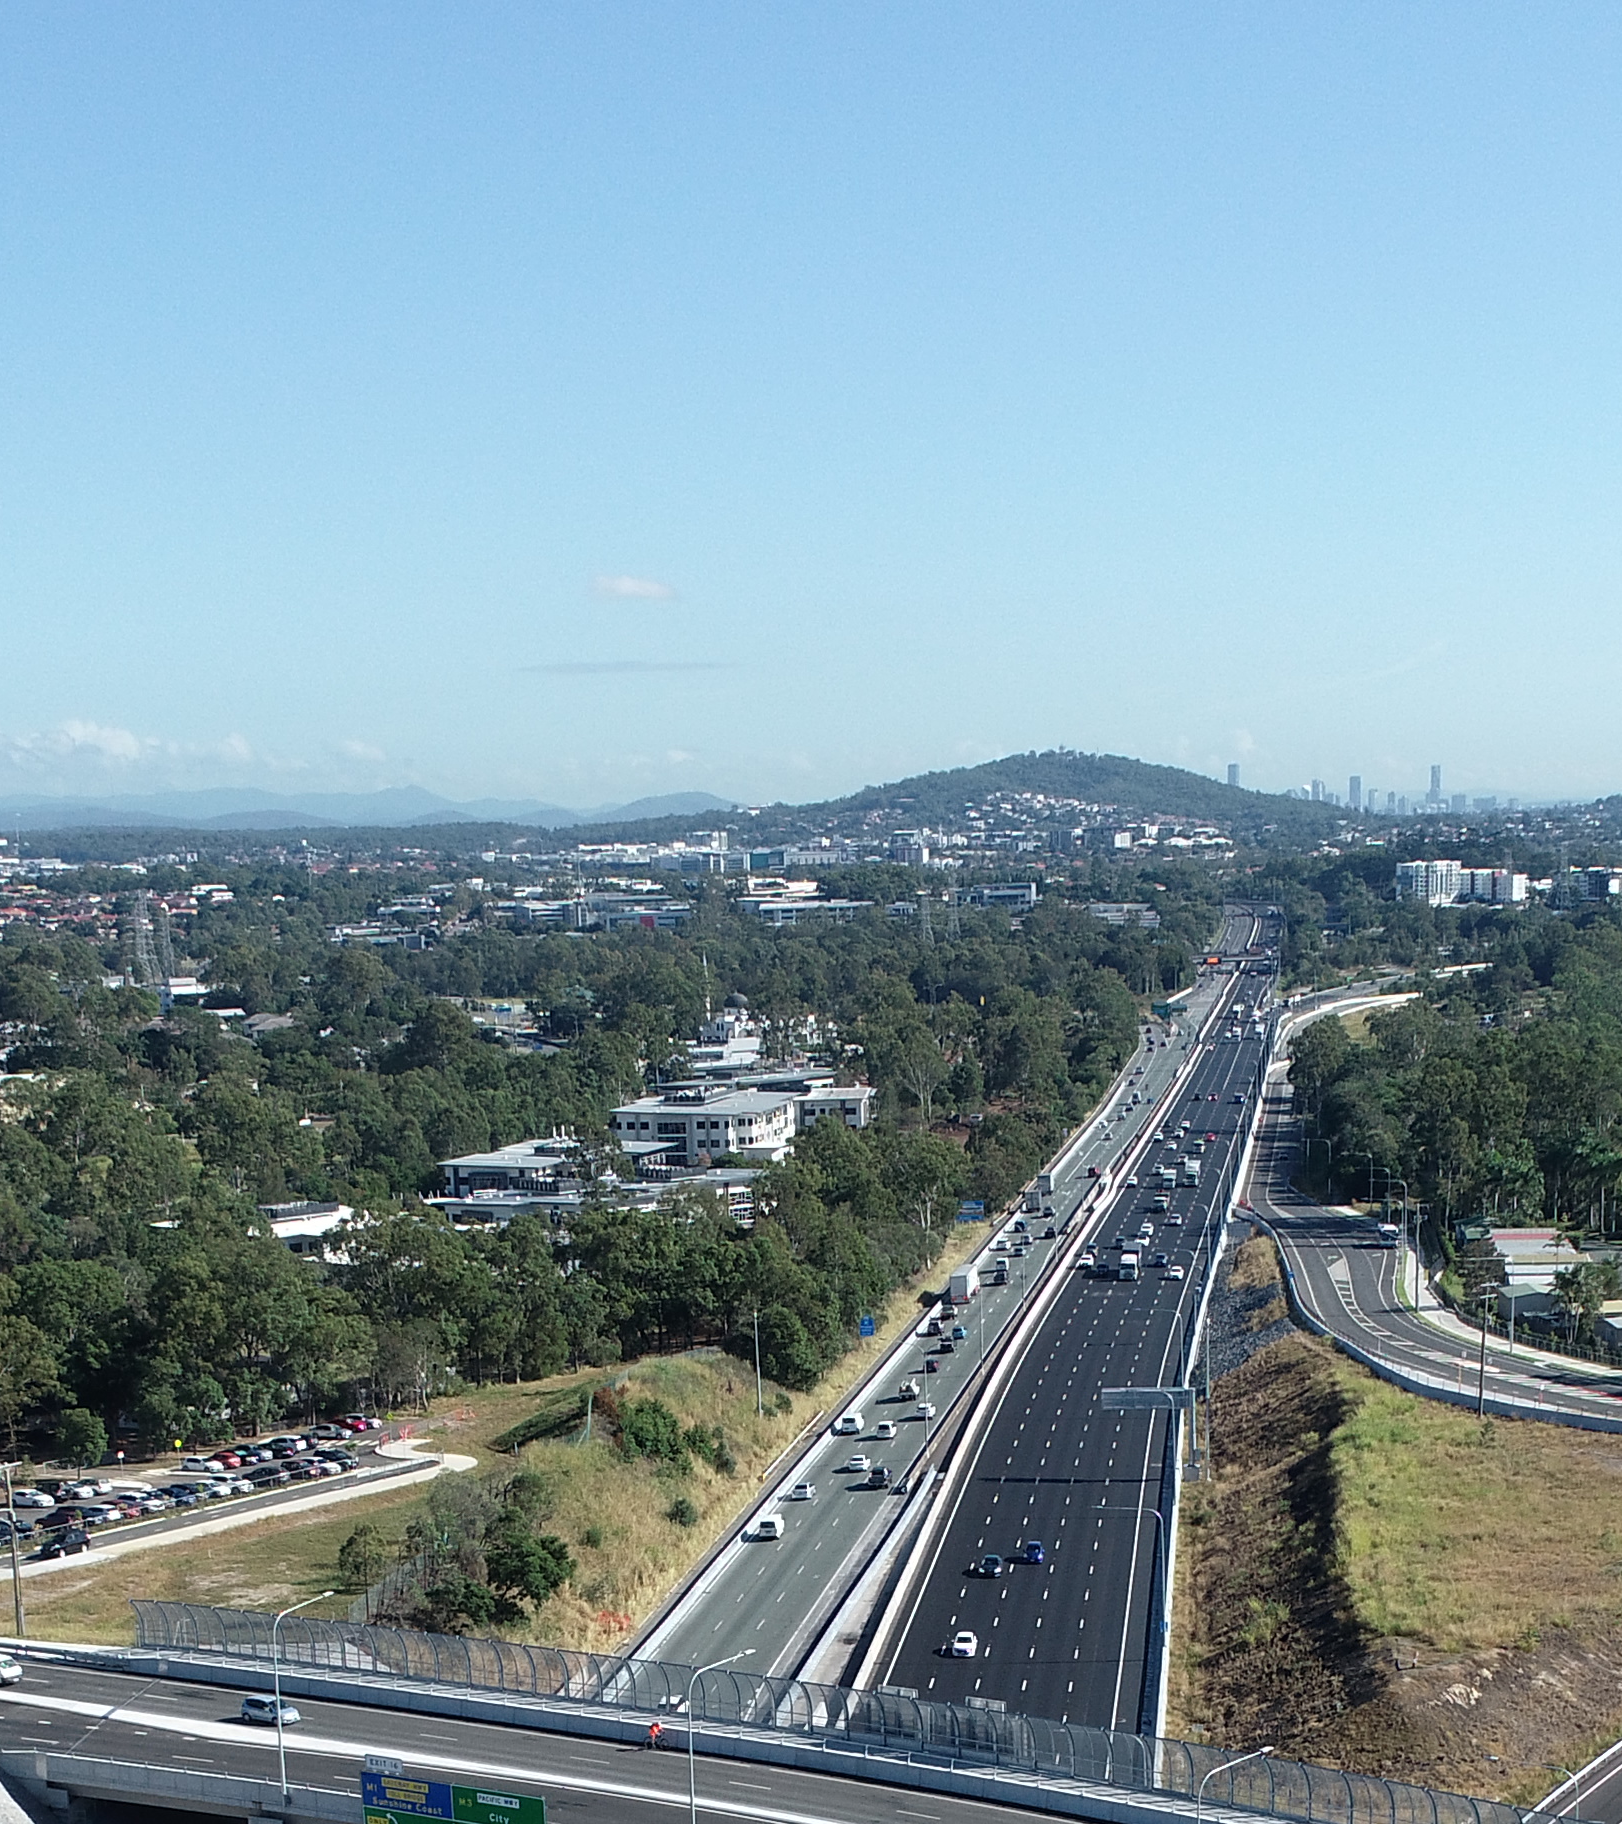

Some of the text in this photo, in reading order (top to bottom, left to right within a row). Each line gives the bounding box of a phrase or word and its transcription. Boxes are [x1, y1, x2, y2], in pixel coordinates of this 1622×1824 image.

[369, 1758, 399, 1770] EXIT 16
[366, 1782, 378, 1792] M1
[458, 1797, 473, 1808] M3
[478, 1794, 501, 1805] PACIFIC
[372, 1796, 443, 1816] Sunshine Coast
